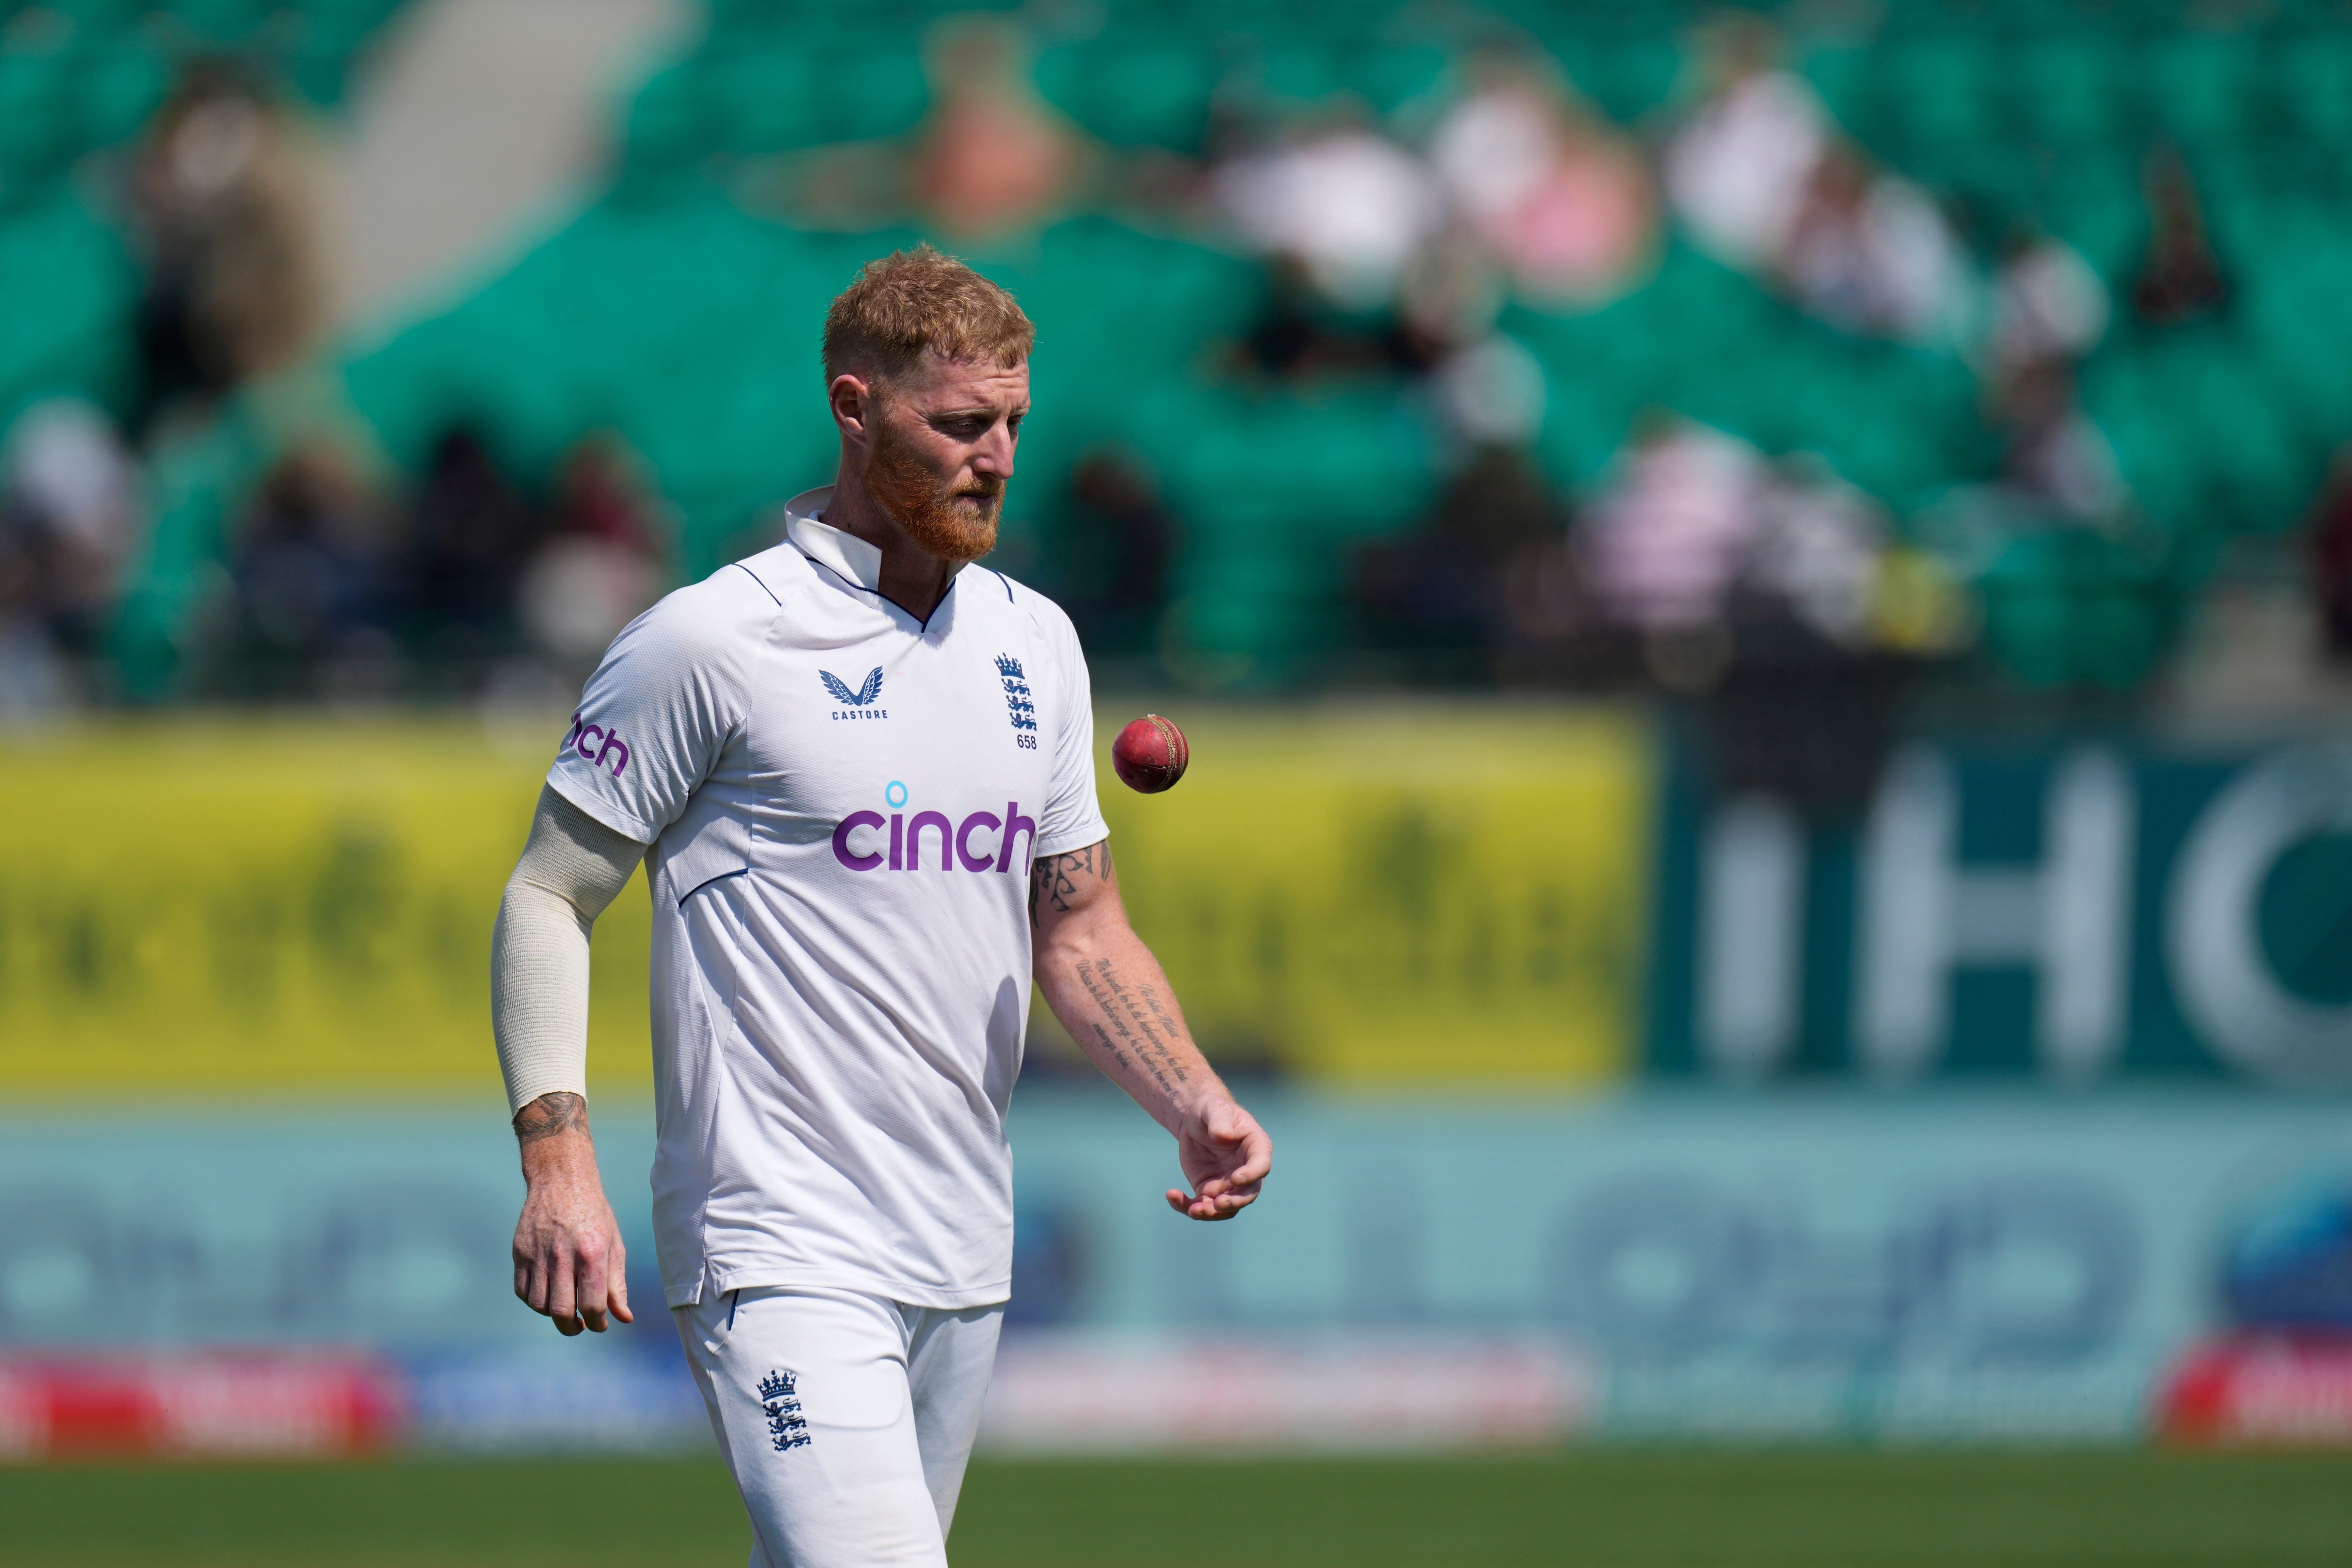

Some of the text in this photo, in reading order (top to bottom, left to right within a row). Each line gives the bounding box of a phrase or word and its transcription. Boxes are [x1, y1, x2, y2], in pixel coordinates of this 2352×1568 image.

[832, 709, 888, 720] CASTORE
[1017, 734, 1037, 750] 658
[832, 780, 1036, 876] cinch
